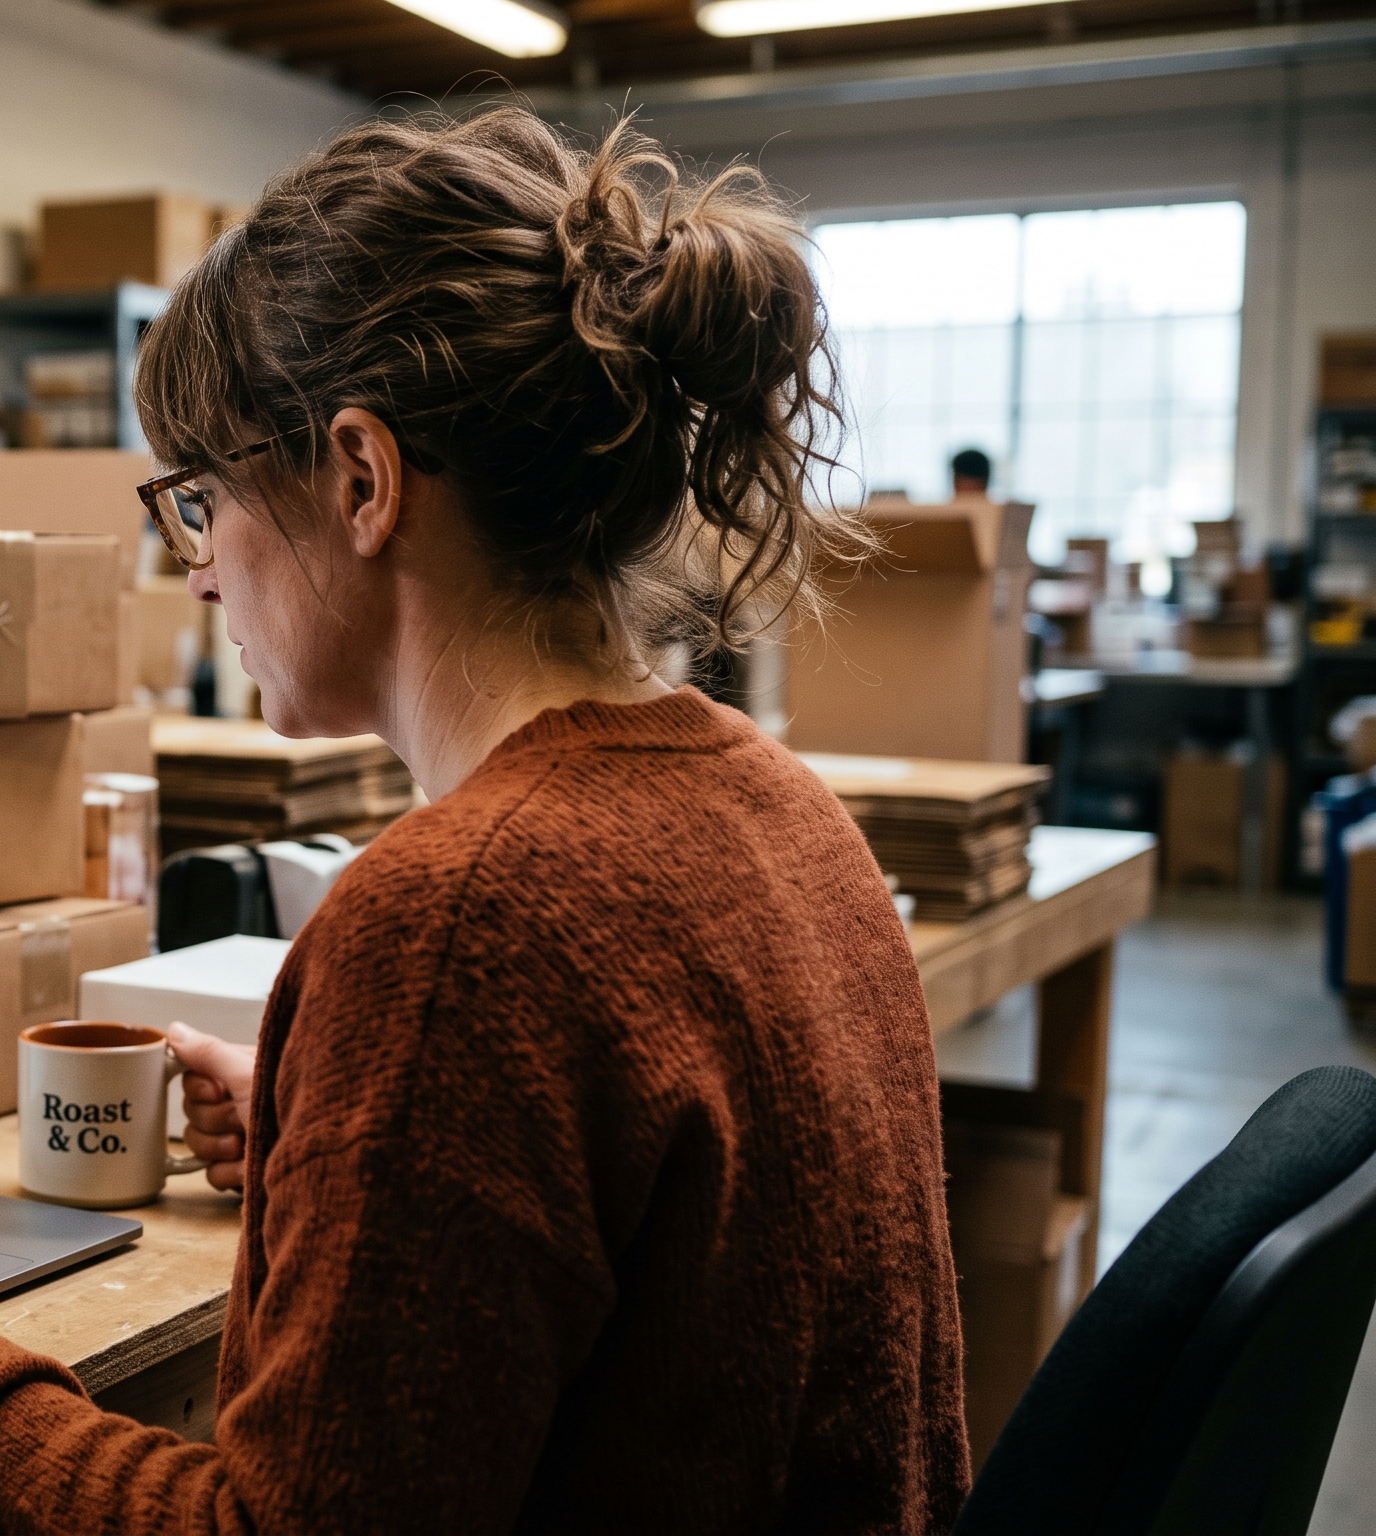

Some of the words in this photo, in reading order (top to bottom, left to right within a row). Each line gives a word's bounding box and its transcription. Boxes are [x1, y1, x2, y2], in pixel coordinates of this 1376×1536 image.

[43, 1093, 132, 1123] Roast
[48, 1125, 70, 1152] &
[77, 1127, 127, 1154] Co.
